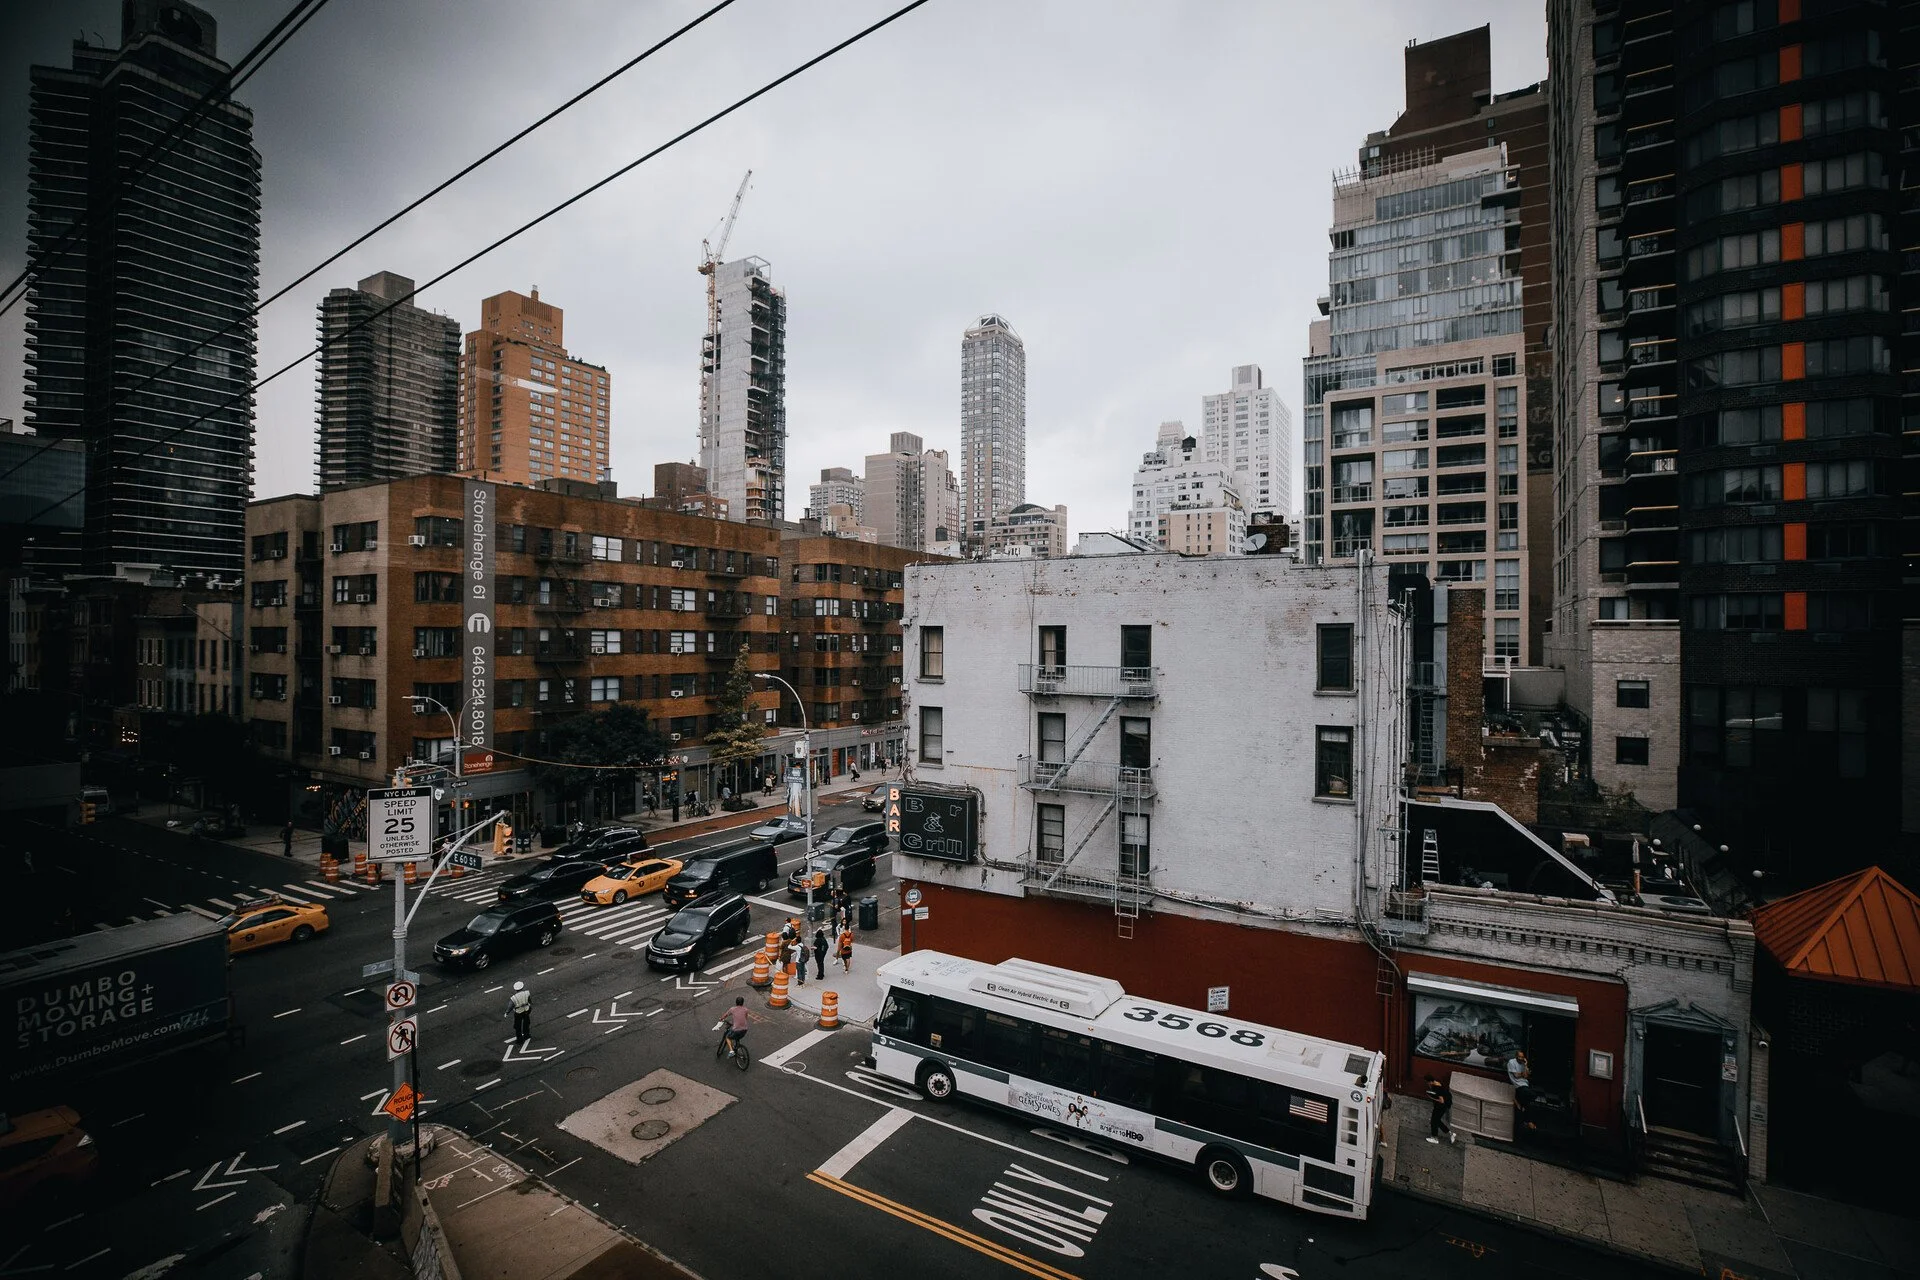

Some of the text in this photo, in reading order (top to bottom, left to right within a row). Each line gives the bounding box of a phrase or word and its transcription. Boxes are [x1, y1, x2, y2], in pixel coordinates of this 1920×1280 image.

[469, 488, 487, 600] Stonehenge 61
[471, 646, 486, 746] 646.524.8018
[384, 800, 417, 809] SPEED
[388, 808, 414, 816] LIMIT
[889, 788, 901, 832] BAR
[384, 817, 415, 835] 25
[380, 840, 420, 849] OTHERWISE
[902, 833, 963, 856] Grill
[454, 853, 459, 862] E
[459, 854, 468, 864] 60
[16, 970, 137, 1015] DUMBO
[900, 977, 915, 987] 3568
[998, 985, 1010, 994] Clean
[1017, 990, 1032, 999] Hybrid
[1032, 994, 1049, 1002] Electric
[17, 986, 136, 1033] MOVING
[17, 997, 155, 1050] STORAGE
[1123, 1006, 1266, 1047] 3568
[8, 1022, 182, 1082] www.DumboMove.com
[396, 1102, 414, 1114] ROAD
[1018, 1095, 1062, 1116] GEMSTONES
[1126, 1130, 1144, 1142] HBO
[972, 1163, 1113, 1258] ONLY
